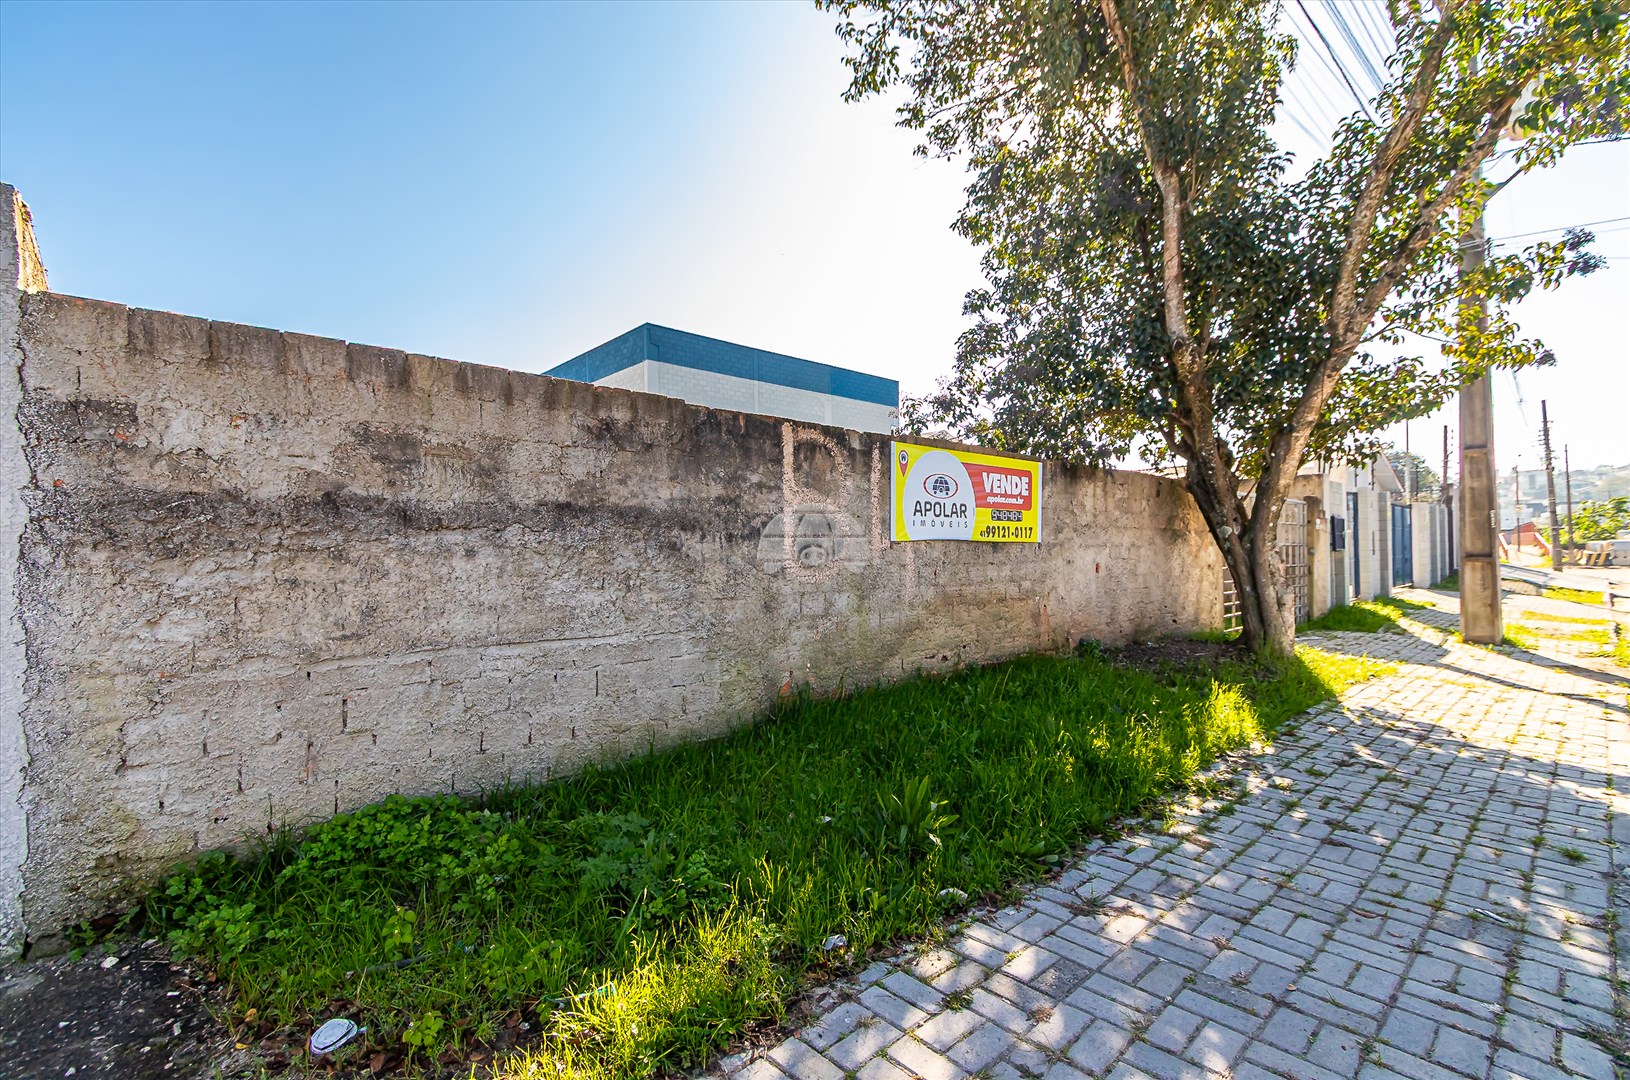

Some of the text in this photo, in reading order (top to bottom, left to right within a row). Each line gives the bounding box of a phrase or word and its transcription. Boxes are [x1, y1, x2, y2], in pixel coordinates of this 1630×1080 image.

[982, 472, 1029, 497] VENDE
[987, 495, 1024, 504] apolar.com.br
[912, 500, 968, 519] APOLAR
[912, 518, 968, 528] IMÓVEIS
